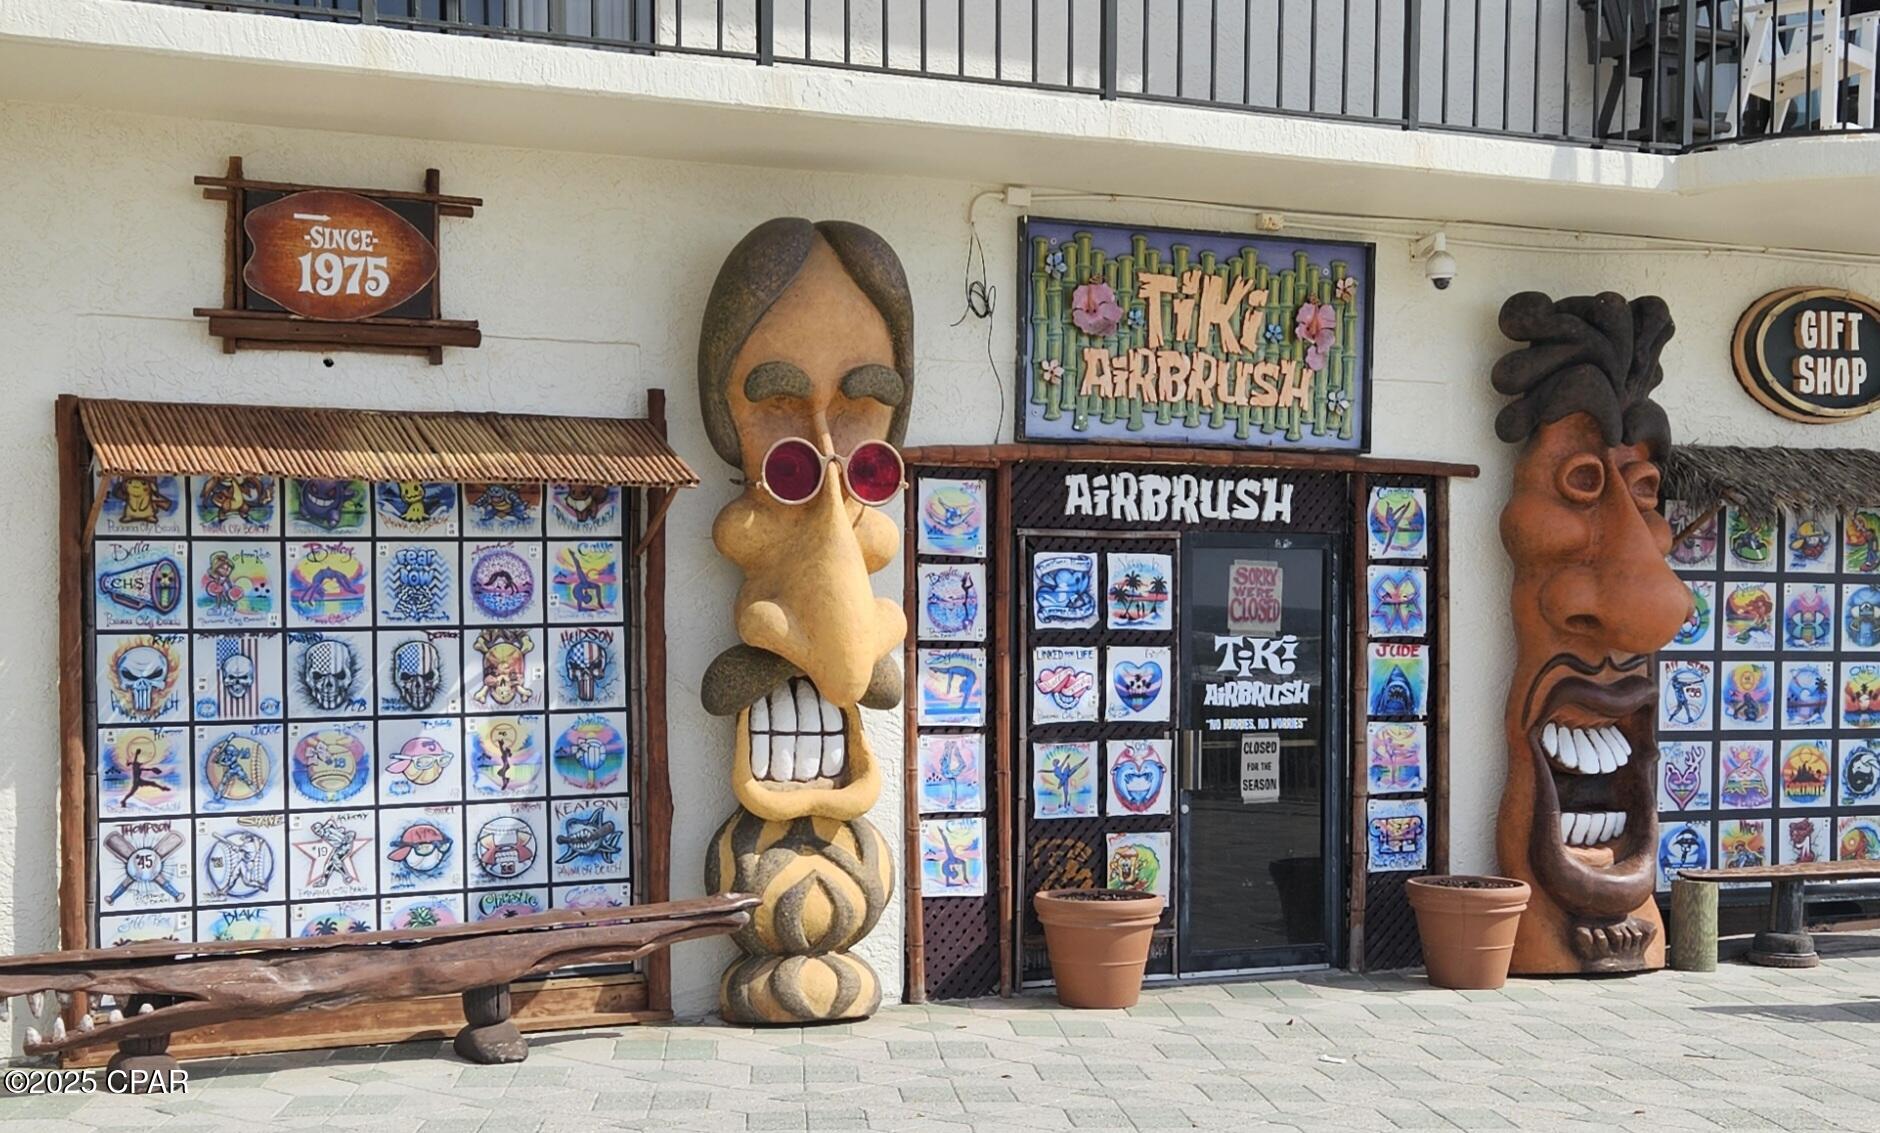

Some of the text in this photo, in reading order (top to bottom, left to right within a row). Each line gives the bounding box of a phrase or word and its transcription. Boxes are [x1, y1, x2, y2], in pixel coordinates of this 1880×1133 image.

[298, 252, 390, 296] 1975
[1800, 309, 1864, 350] GIFT
[1798, 354, 1868, 396] SHOP
[1233, 567, 1279, 586] SORRY
[1230, 597, 1280, 624] CLOSED
[1376, 643, 1421, 659] JUDE
[1247, 762, 1272, 772] FOR THE
[1242, 778, 1277, 791] SEASON
[555, 800, 618, 820] KEATON
[119, 822, 172, 837] THOMPSON
[219, 908, 267, 926] BLAKE
